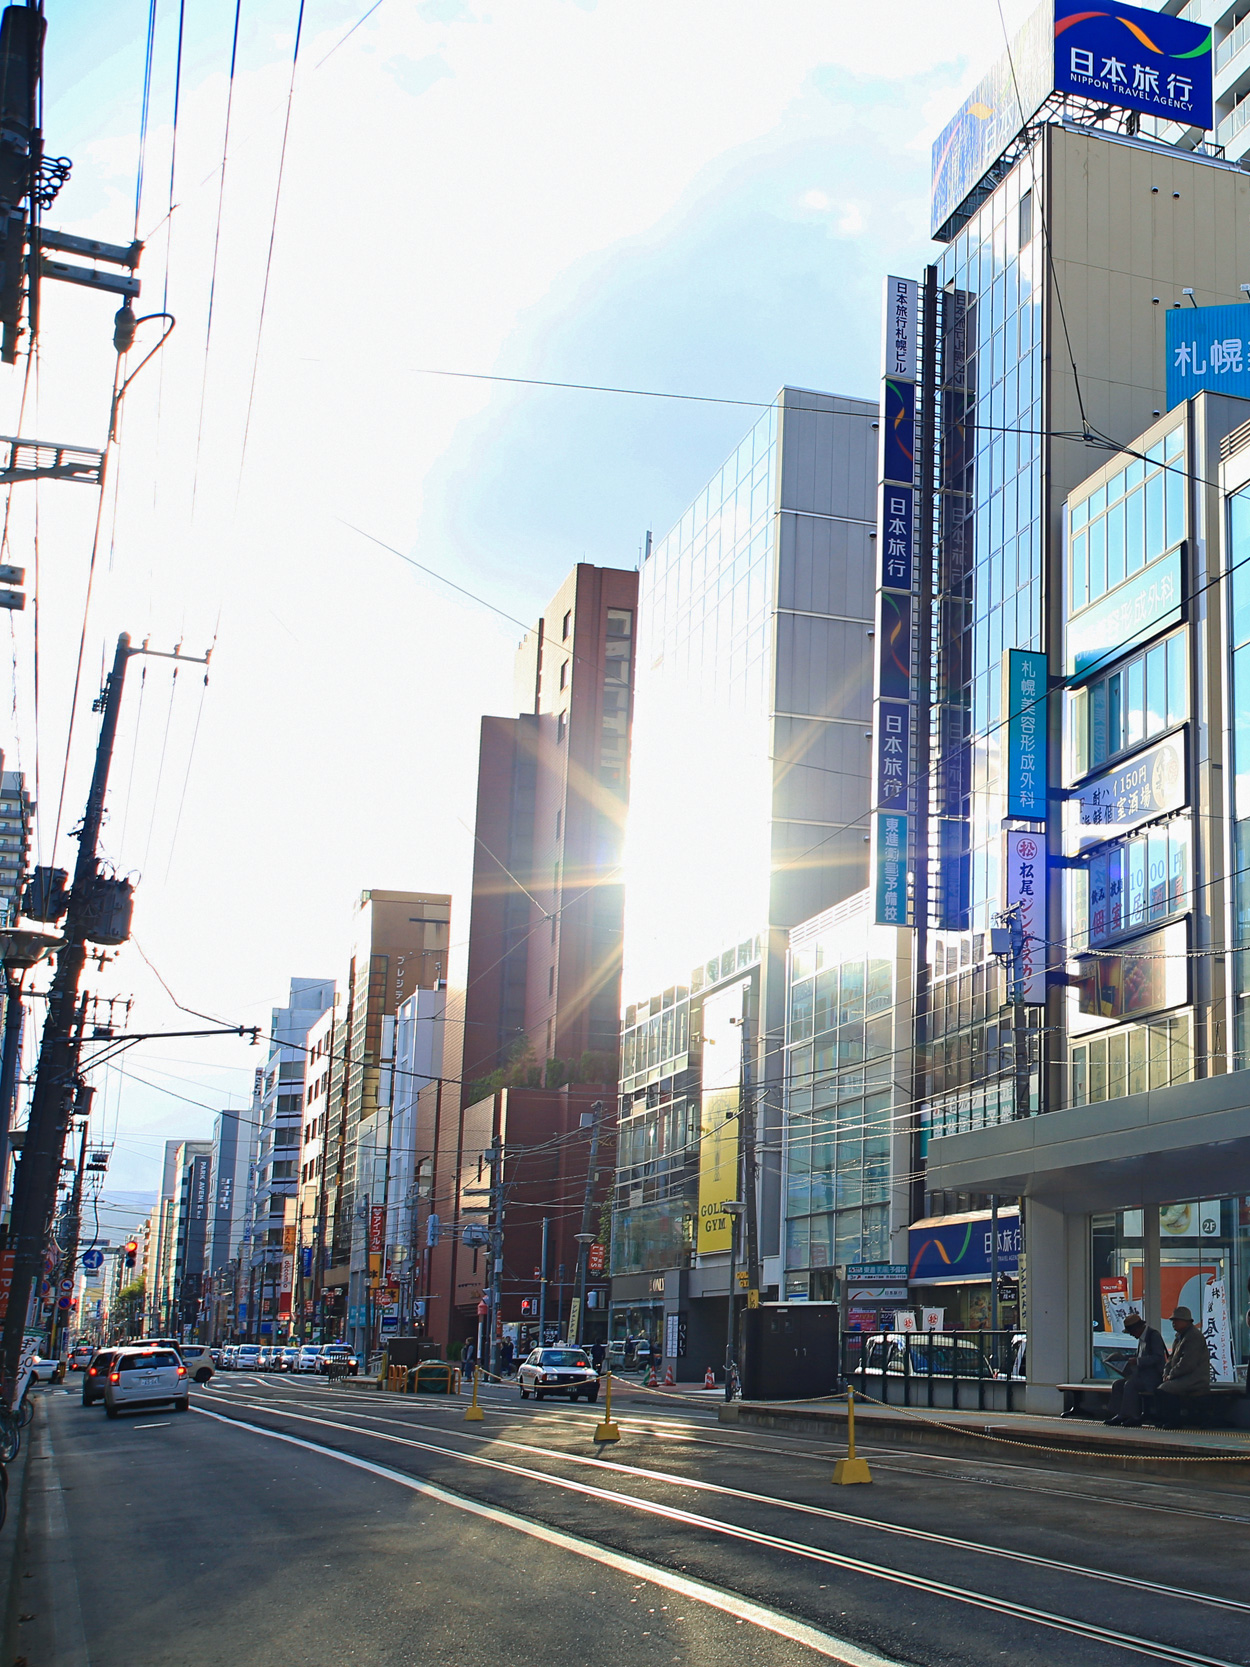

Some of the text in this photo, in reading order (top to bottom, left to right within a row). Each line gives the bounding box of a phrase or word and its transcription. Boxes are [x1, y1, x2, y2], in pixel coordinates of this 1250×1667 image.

[1069, 46, 1194, 103] 日本旅行
[1069, 72, 1194, 113] NIPPON TRAVEL AGENCY
[895, 282, 908, 374] 日本旅行札幌ビル
[887, 497, 907, 578] 日本旅行
[882, 715, 903, 798] 日本旅行
[1019, 659, 1037, 809] 札幌美容形成外科
[884, 817, 899, 922] 東進衛星予備校
[199, 1161, 207, 1180] PARK
[372, 1216, 382, 1246] アイフル
[705, 1217, 727, 1233] GYM
[1203, 1222, 1216, 1232] 2F
[283, 1260, 292, 1289] docomo
